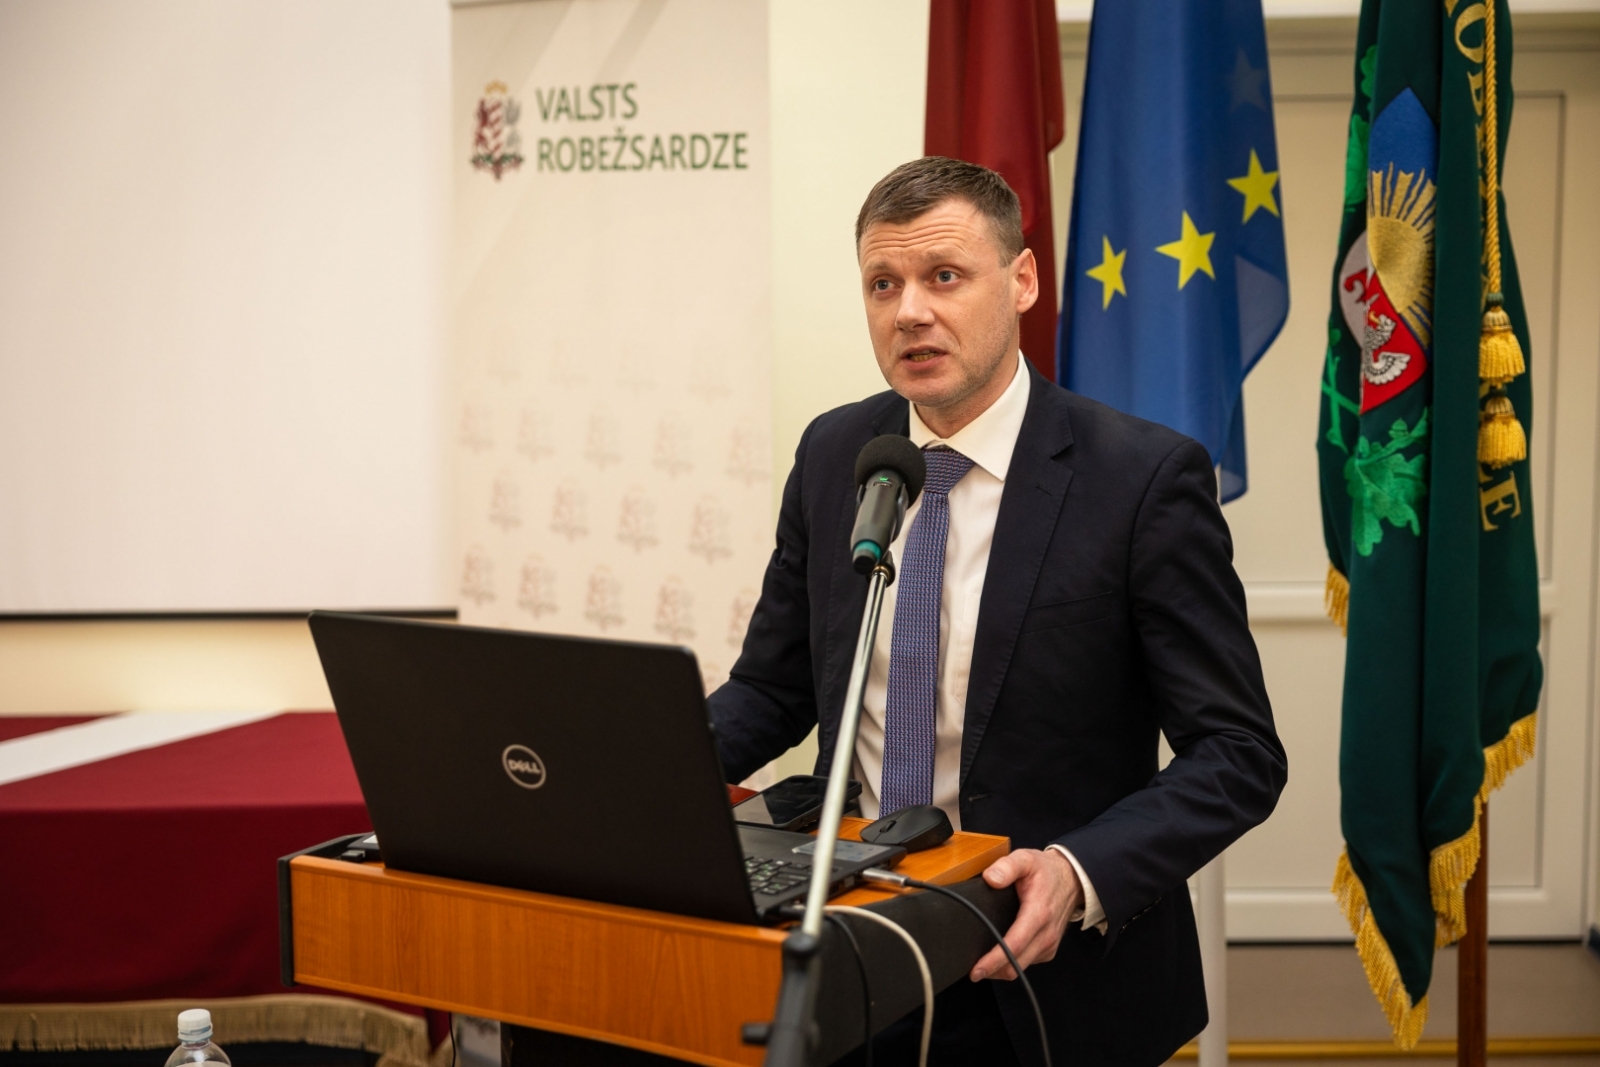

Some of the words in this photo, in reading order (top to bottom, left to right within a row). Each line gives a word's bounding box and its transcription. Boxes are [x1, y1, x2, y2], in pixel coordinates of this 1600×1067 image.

[536, 83, 638, 121] VALSTS
[537, 126, 748, 171] ROBEŽSARDZE
[508, 759, 541, 774] DELL
